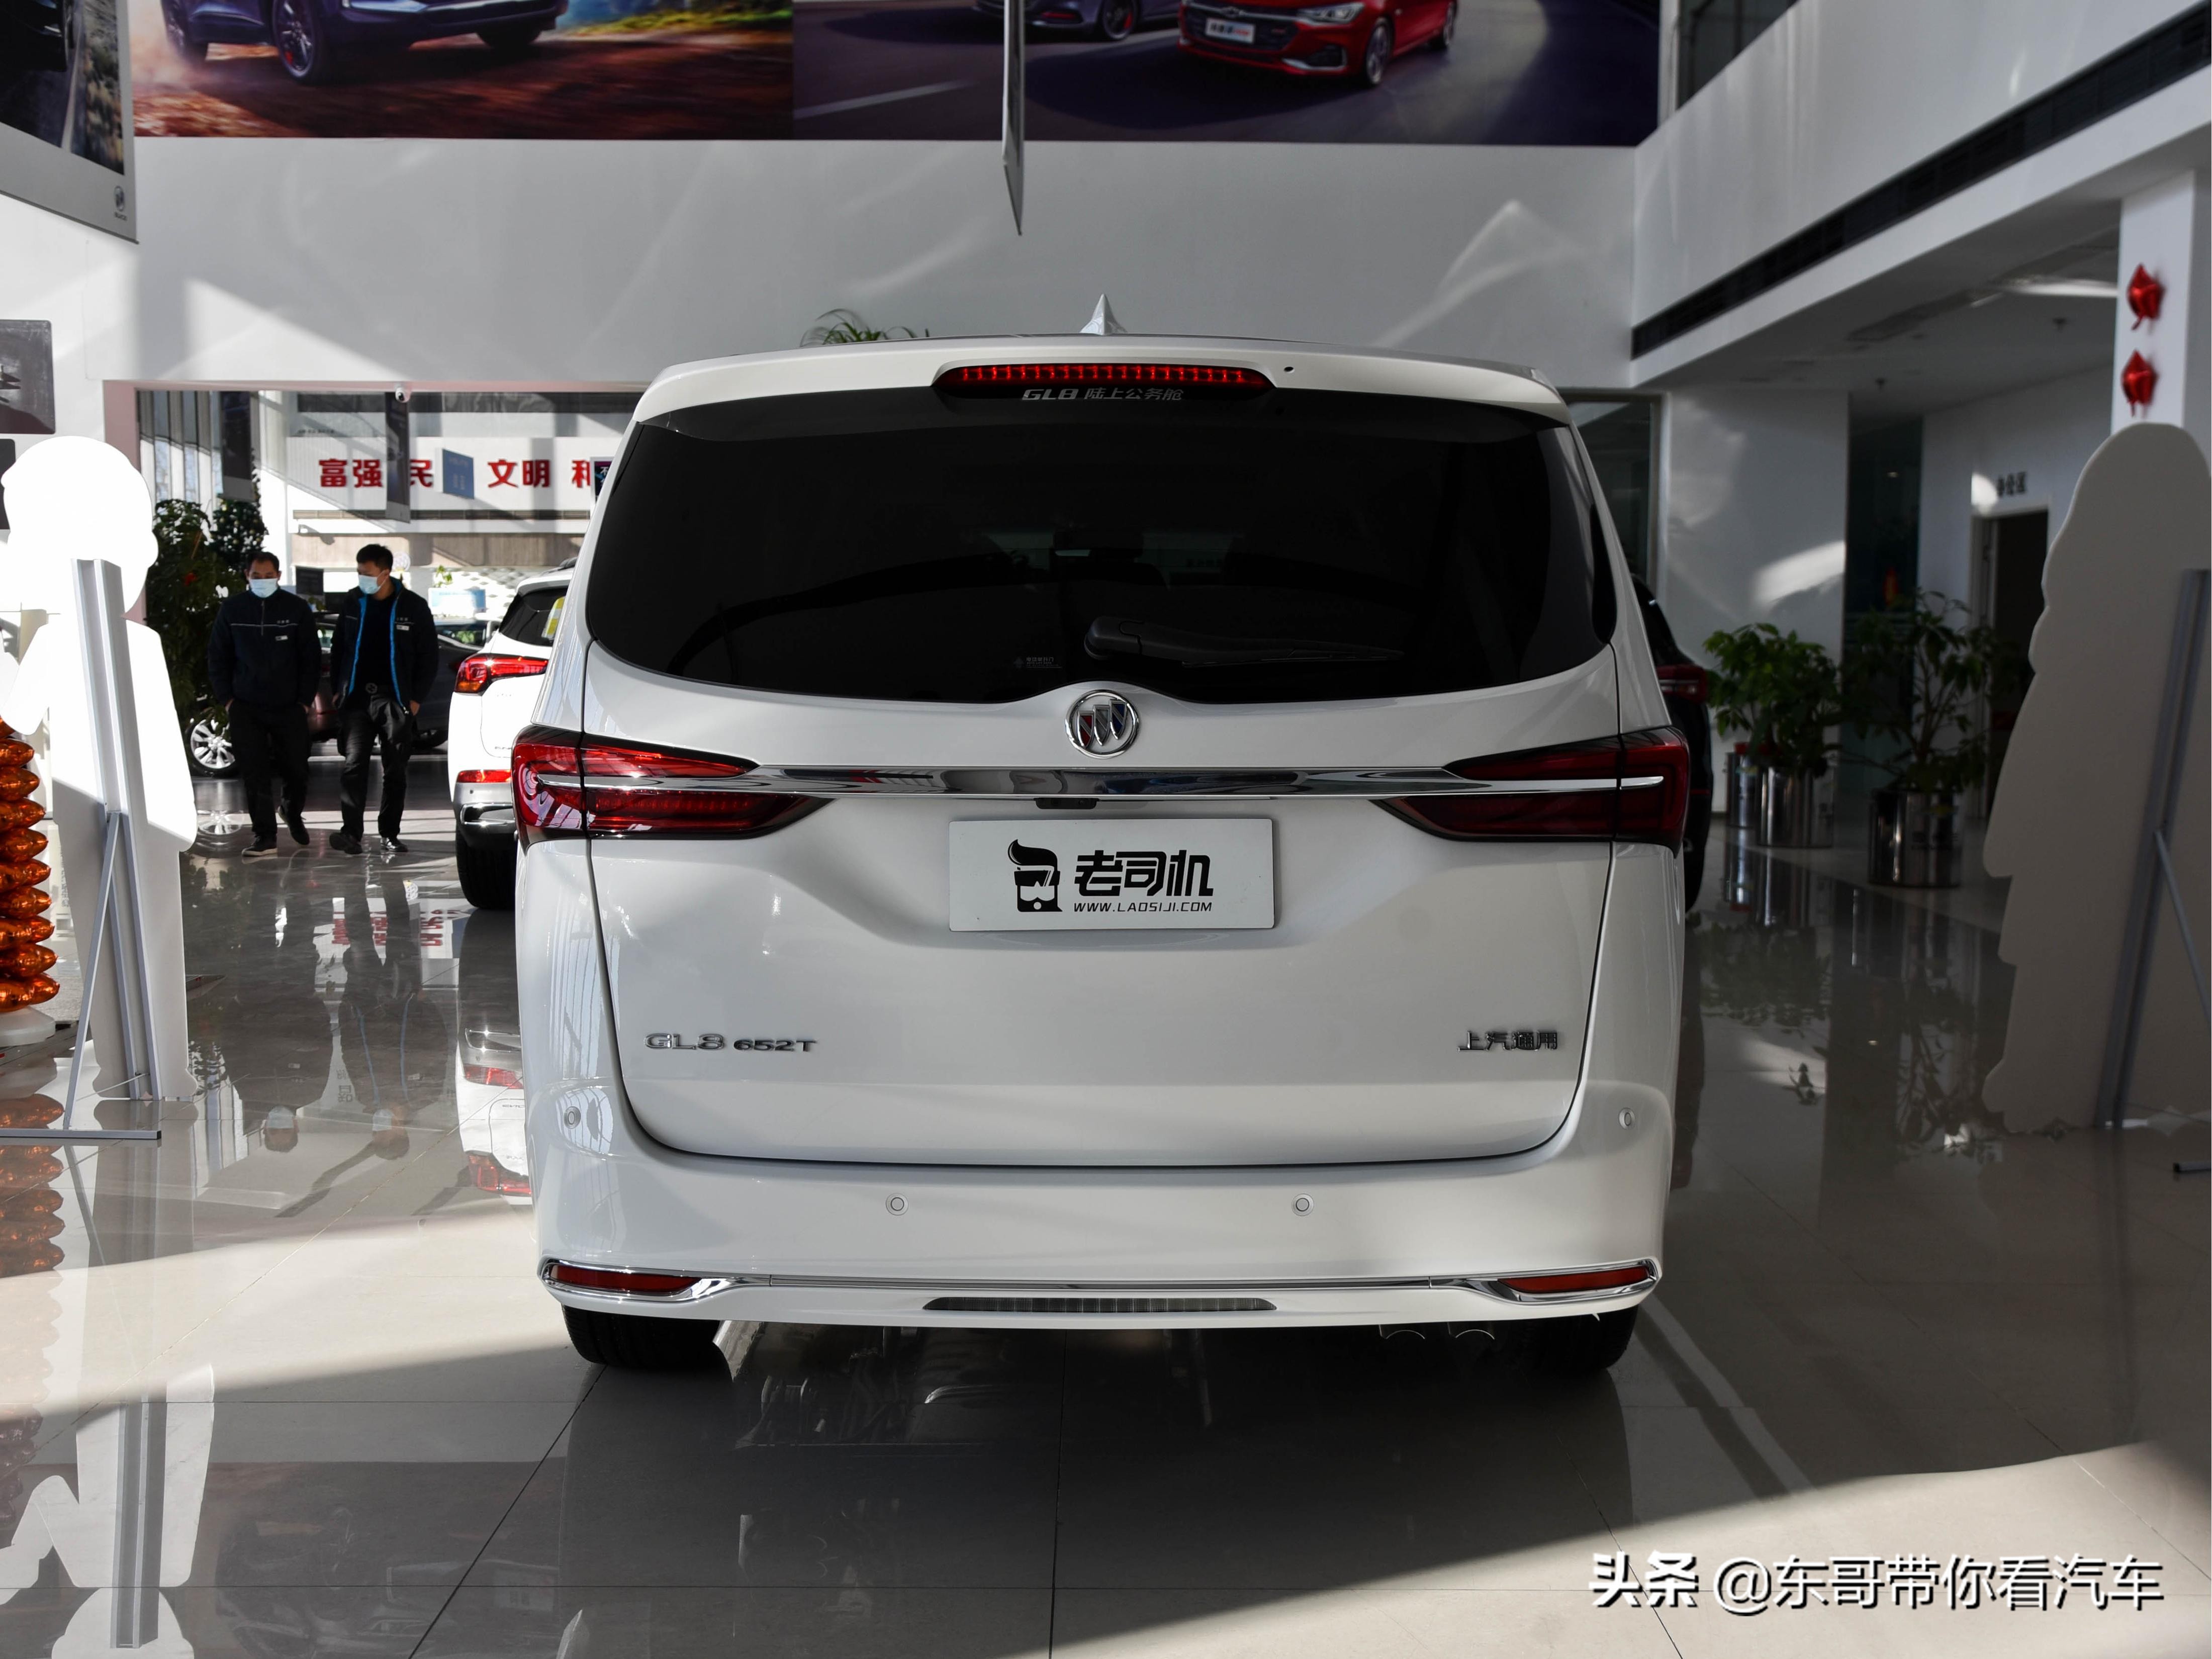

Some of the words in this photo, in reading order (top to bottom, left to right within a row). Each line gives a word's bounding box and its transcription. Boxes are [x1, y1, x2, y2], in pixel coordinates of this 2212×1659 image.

[1022, 389, 1079, 400] GL8
[1084, 388, 1184, 401] 陆上公务舱
[319, 458, 384, 488] 富强
[488, 458, 550, 488] 文明
[1074, 850, 1214, 896] 老司机
[1074, 901, 1213, 912] WWW.LAOSIJI.COM
[643, 1033, 725, 1050] GL8
[733, 1038, 817, 1052] 652T
[1456, 1031, 1558, 1051] 上汽通用
